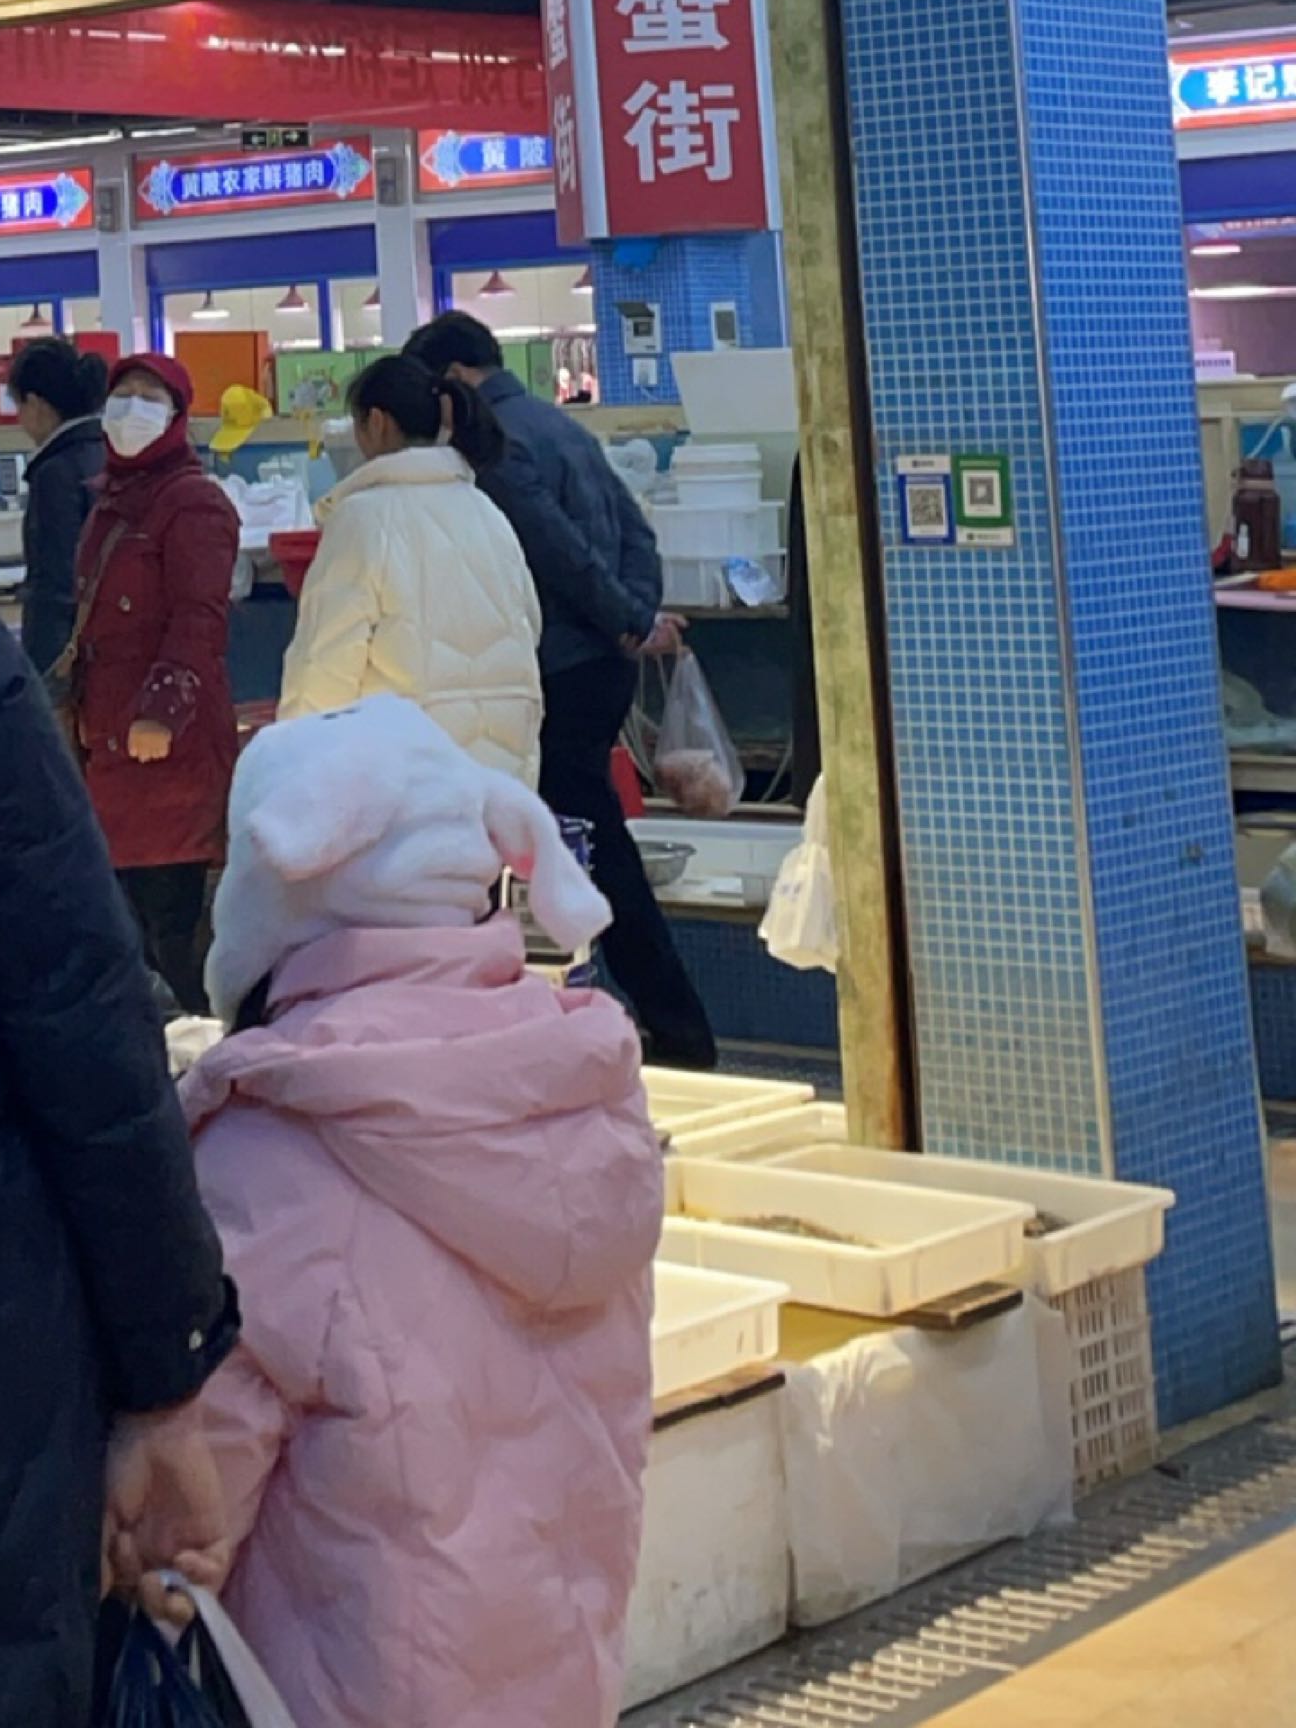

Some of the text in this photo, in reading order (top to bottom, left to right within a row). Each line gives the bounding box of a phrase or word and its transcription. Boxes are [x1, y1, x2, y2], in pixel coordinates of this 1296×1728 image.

[182, 159, 325, 200] 黄陂农家鲜猪肉
